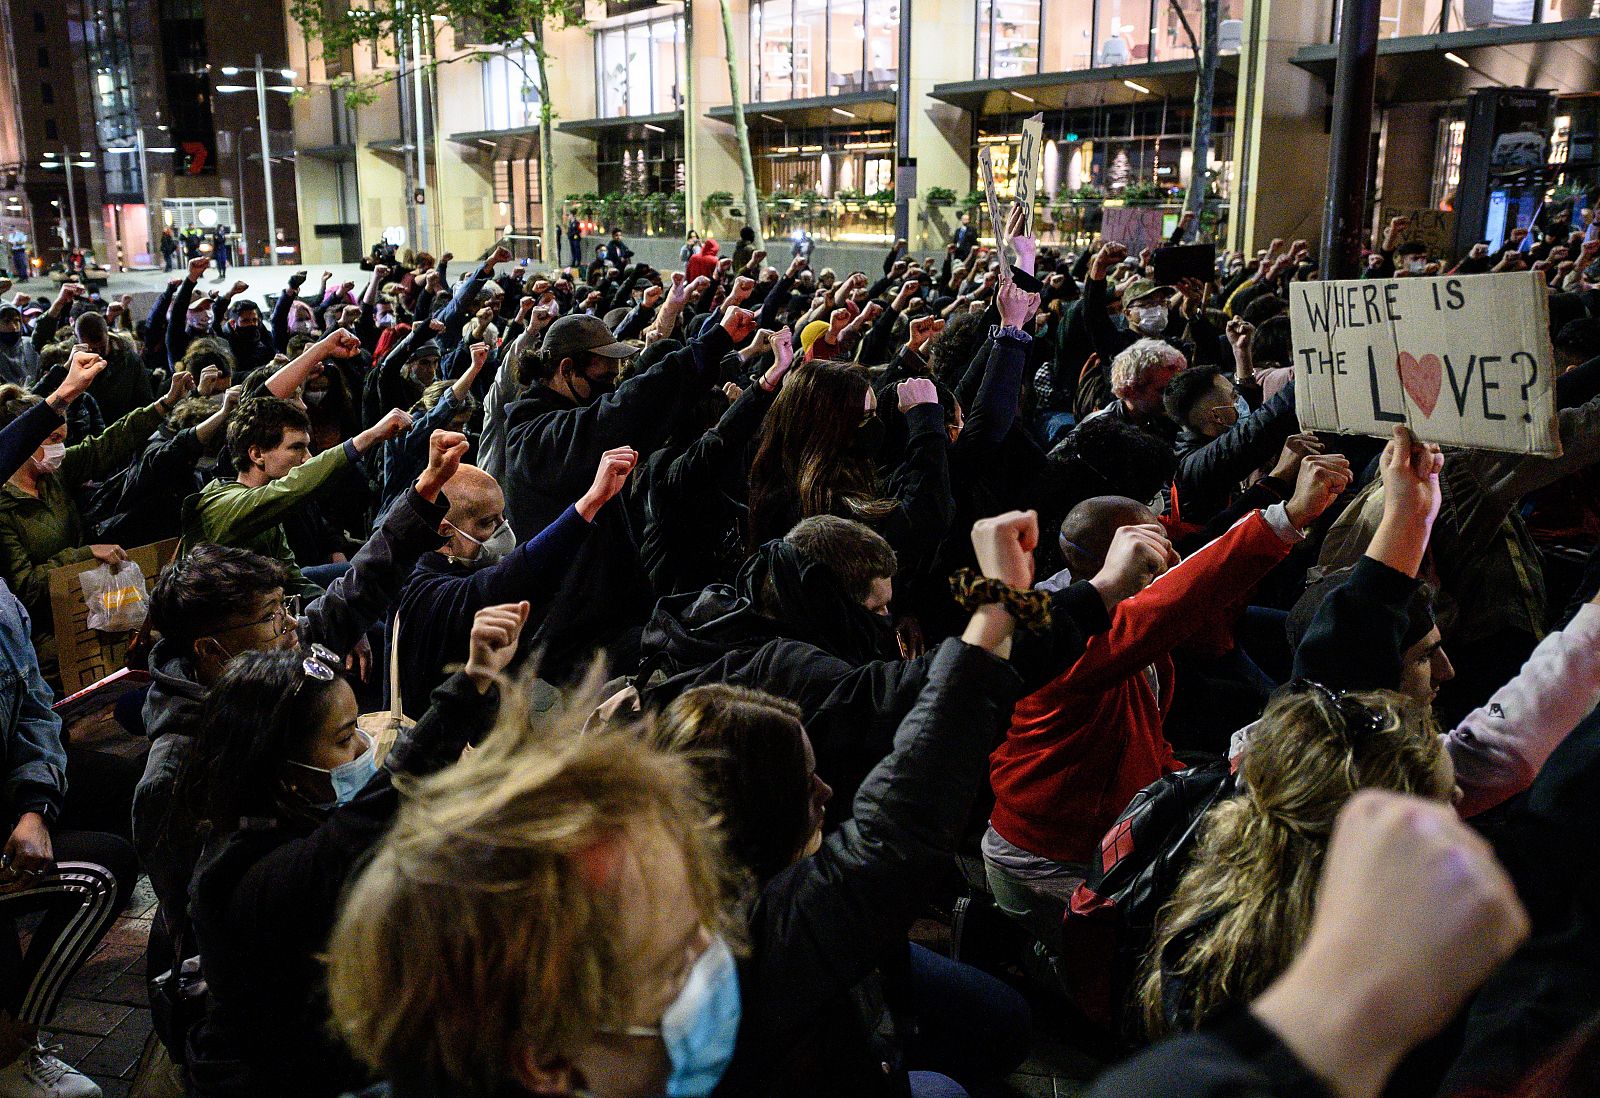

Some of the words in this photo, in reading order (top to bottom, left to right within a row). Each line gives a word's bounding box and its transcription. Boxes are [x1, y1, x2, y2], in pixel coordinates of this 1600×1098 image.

[1385, 209, 1446, 230] BACK
[1302, 283, 1402, 332] WHERE
[1432, 279, 1465, 311] IS
[1299, 347, 1348, 375] THE
